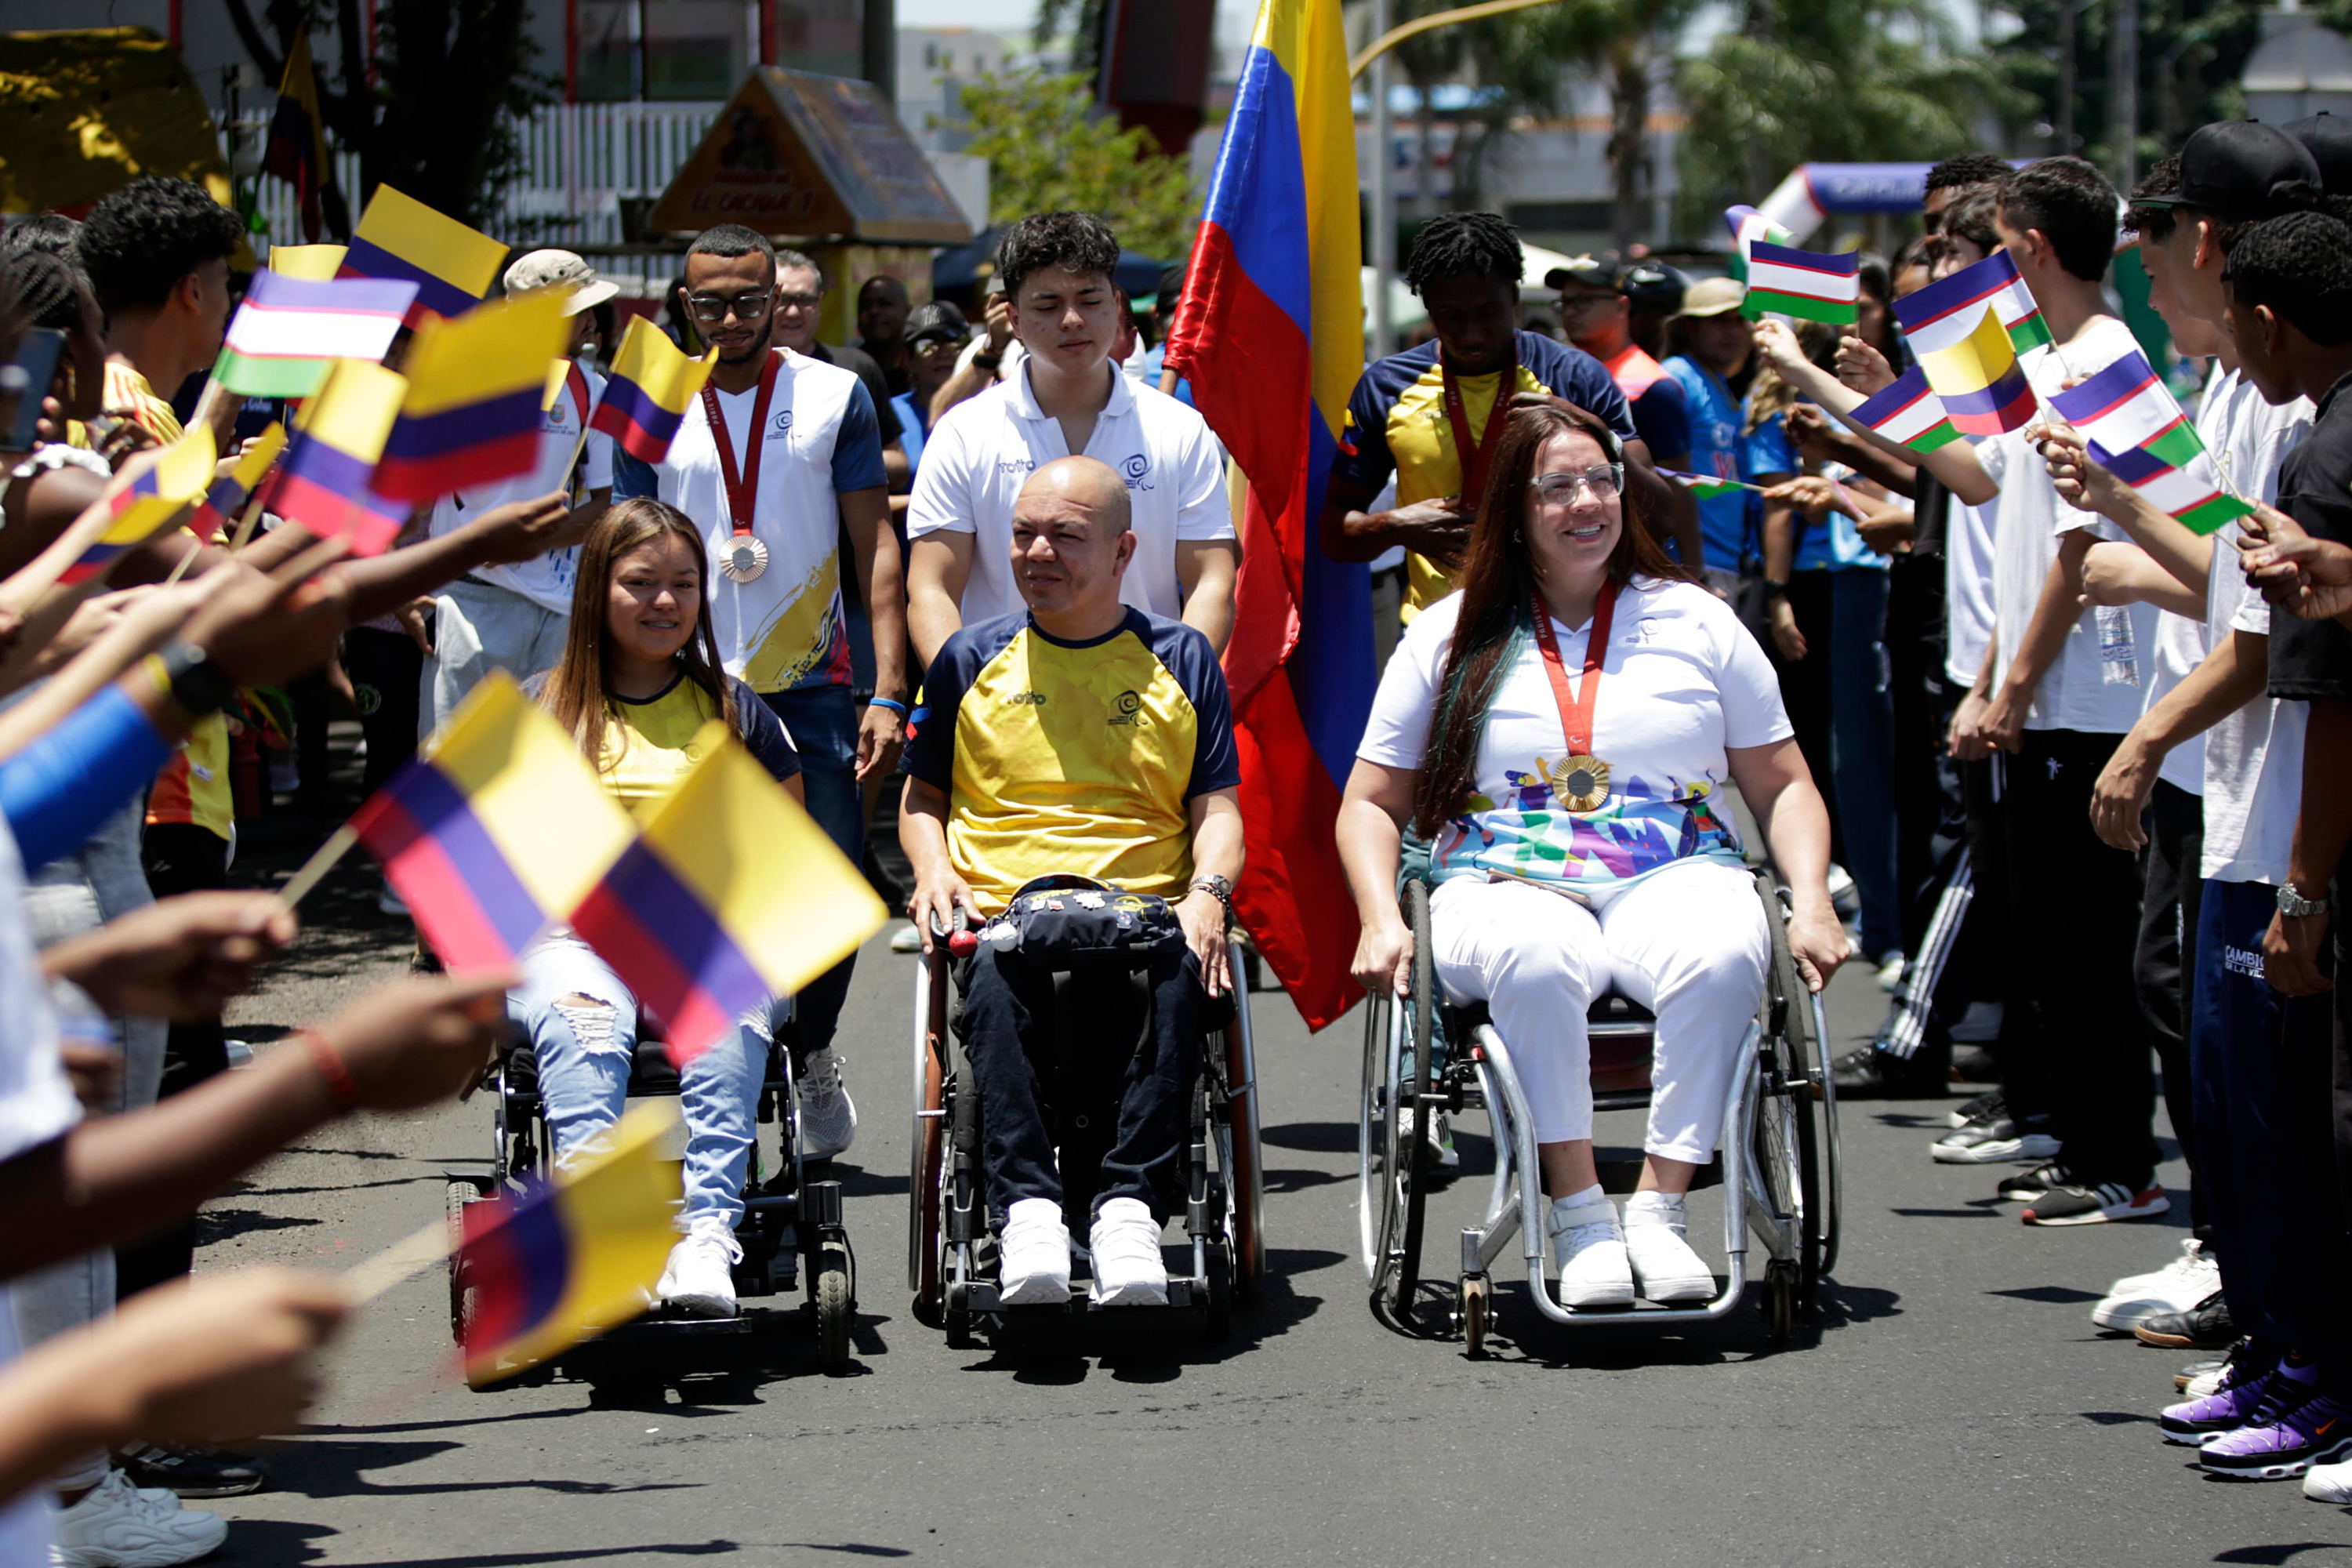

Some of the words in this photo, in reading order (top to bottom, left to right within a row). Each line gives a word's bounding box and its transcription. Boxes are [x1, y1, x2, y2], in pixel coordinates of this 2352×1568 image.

[708, 402, 720, 425] PARIS
[1535, 615, 1548, 639] PARIS
[2234, 964, 2246, 975] LA
[2249, 967, 2264, 979] VID
